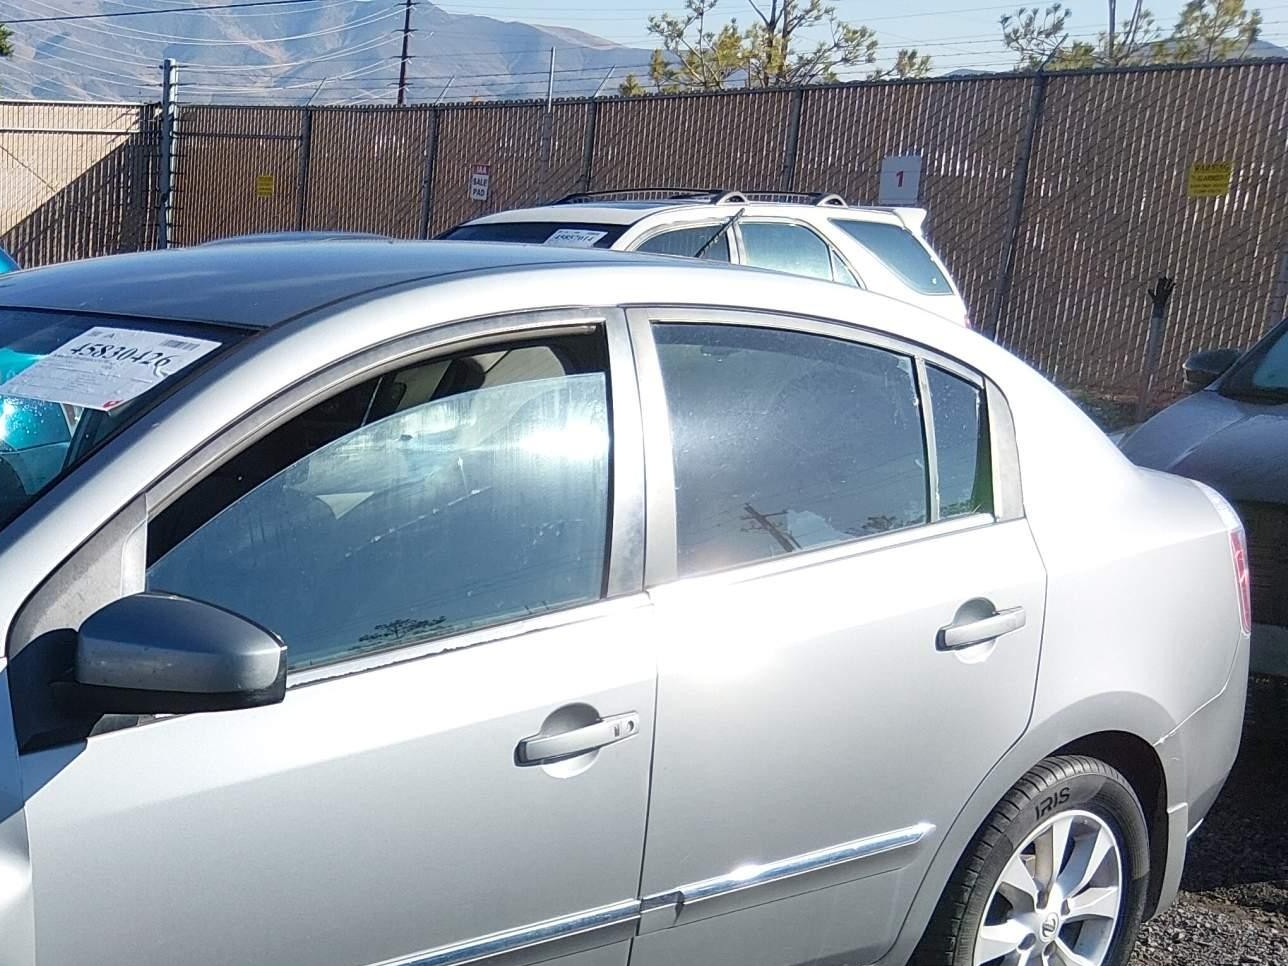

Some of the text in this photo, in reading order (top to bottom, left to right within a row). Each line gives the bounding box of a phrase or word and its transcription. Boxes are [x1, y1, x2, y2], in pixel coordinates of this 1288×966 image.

[473, 177, 487, 186] SALE
[896, 170, 904, 188] 1
[70, 342, 172, 367] 45830426
[1035, 786, 1070, 820] IRIS
